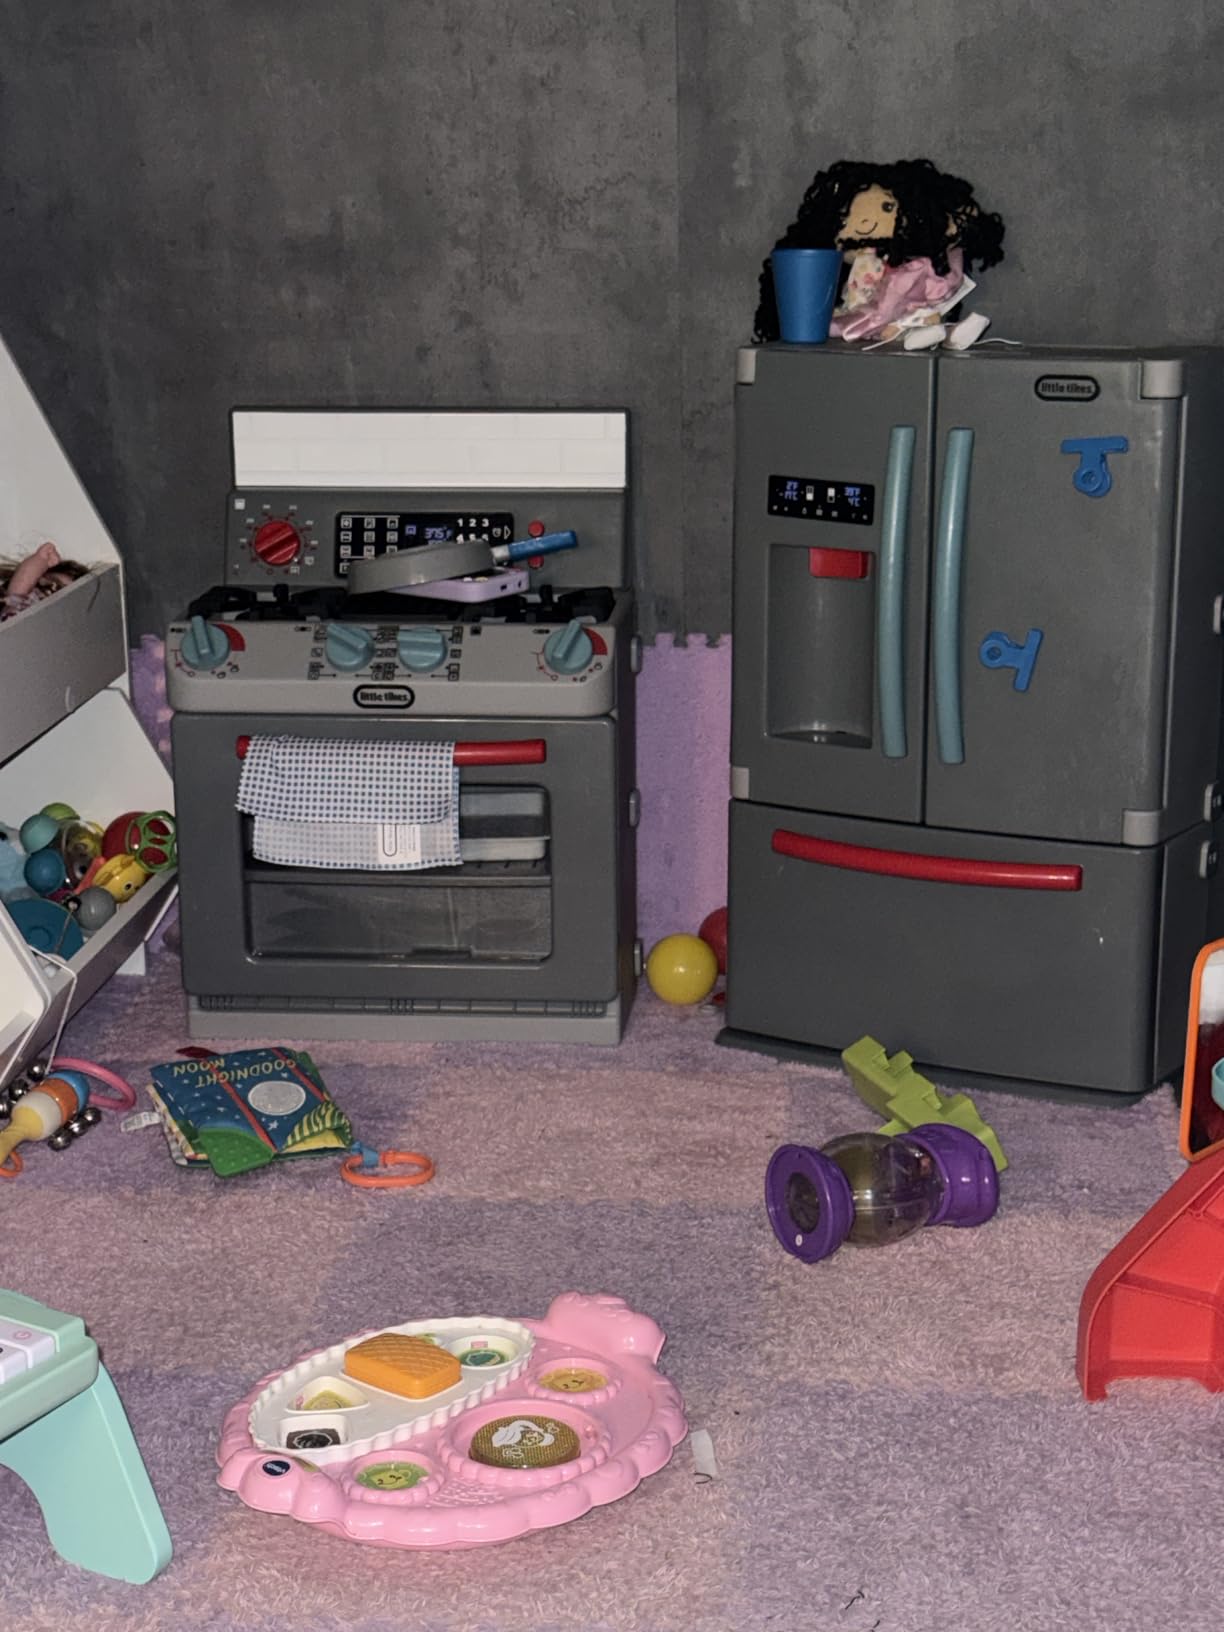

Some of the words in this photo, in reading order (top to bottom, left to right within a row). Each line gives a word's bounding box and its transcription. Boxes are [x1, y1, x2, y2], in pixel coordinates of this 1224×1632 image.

[1041, 382, 1064, 393] little
[457, 518, 464, 527] 1
[469, 518, 477, 527] 2
[482, 518, 489, 527] 3
[360, 691, 383, 701] little
[173, 1057, 226, 1077] MOON
[195, 1059, 296, 1088] GOODNIGHT
